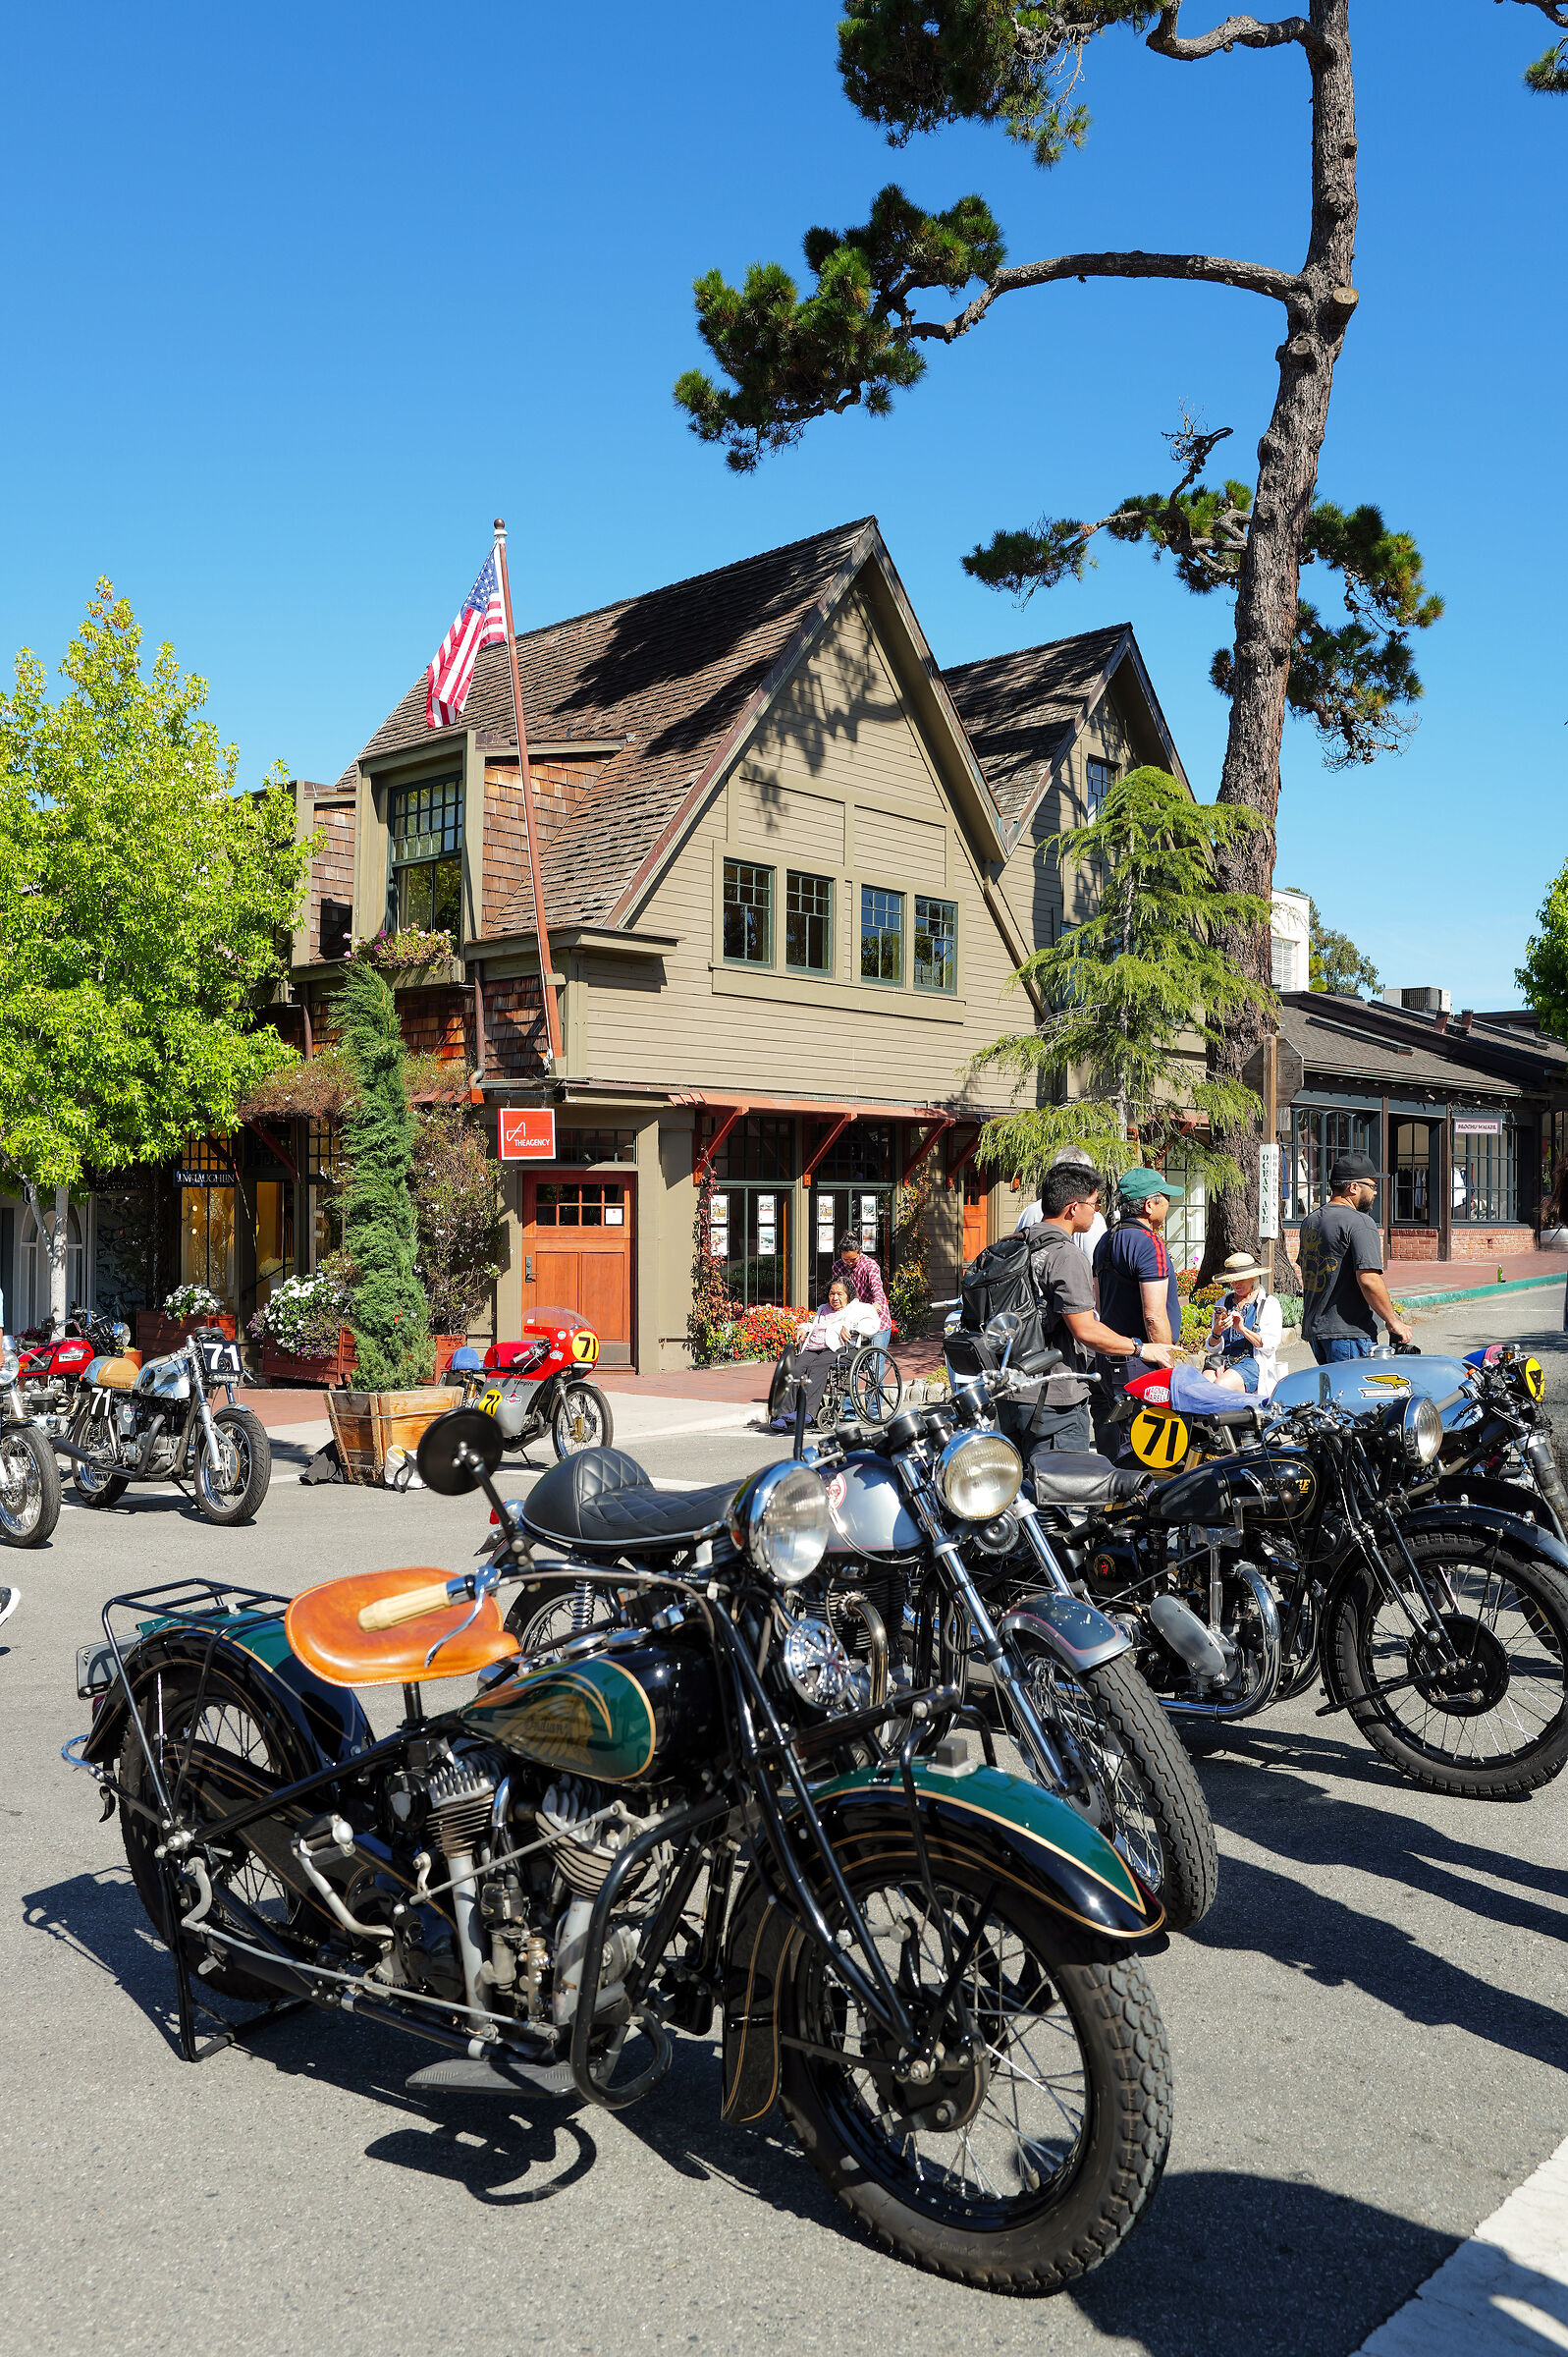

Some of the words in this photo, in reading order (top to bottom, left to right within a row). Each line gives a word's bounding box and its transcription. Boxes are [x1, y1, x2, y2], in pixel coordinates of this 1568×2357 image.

[202, 1343, 241, 1372] 71
[578, 1336, 597, 1360] 71
[90, 1387, 112, 1417] 71
[484, 1394, 501, 1414] 71
[1142, 1413, 1180, 1462] 71
